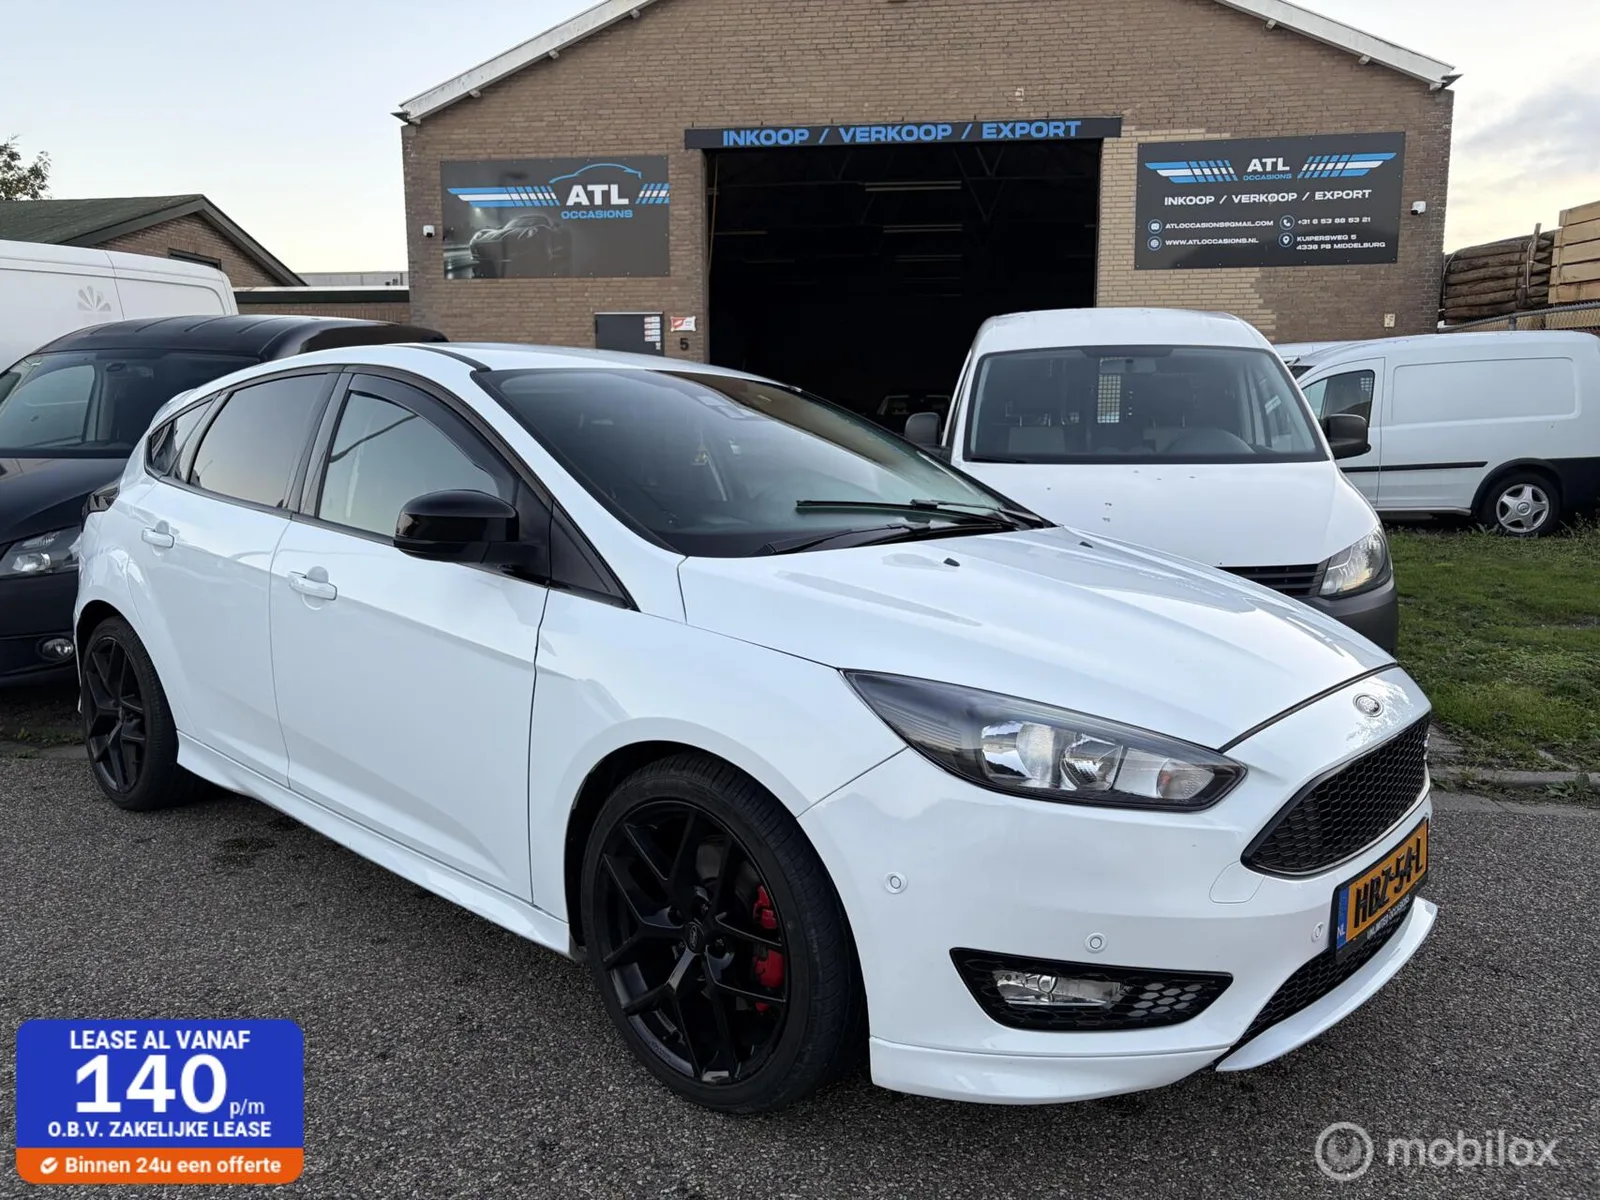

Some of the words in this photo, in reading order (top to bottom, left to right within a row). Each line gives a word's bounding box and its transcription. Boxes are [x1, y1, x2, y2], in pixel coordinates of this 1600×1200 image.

[723, 128, 809, 147] INKOOP
[839, 124, 952, 143] VERKOOP
[982, 121, 1081, 139] EXPORT
[1247, 157, 1290, 172] ATL
[1243, 173, 1292, 181] OCCASIONS
[566, 184, 629, 206] ATL
[1164, 195, 1215, 206] INKOOP
[1231, 192, 1298, 204] VERKOOP
[1315, 189, 1372, 200] EXPORT
[561, 209, 633, 219] OCCASIONS
[1165, 237, 1259, 246] WWW.ATLOCCASIONS.NL
[1333, 241, 1386, 249] MIDDELBURG
[680, 338, 690, 351] 5
